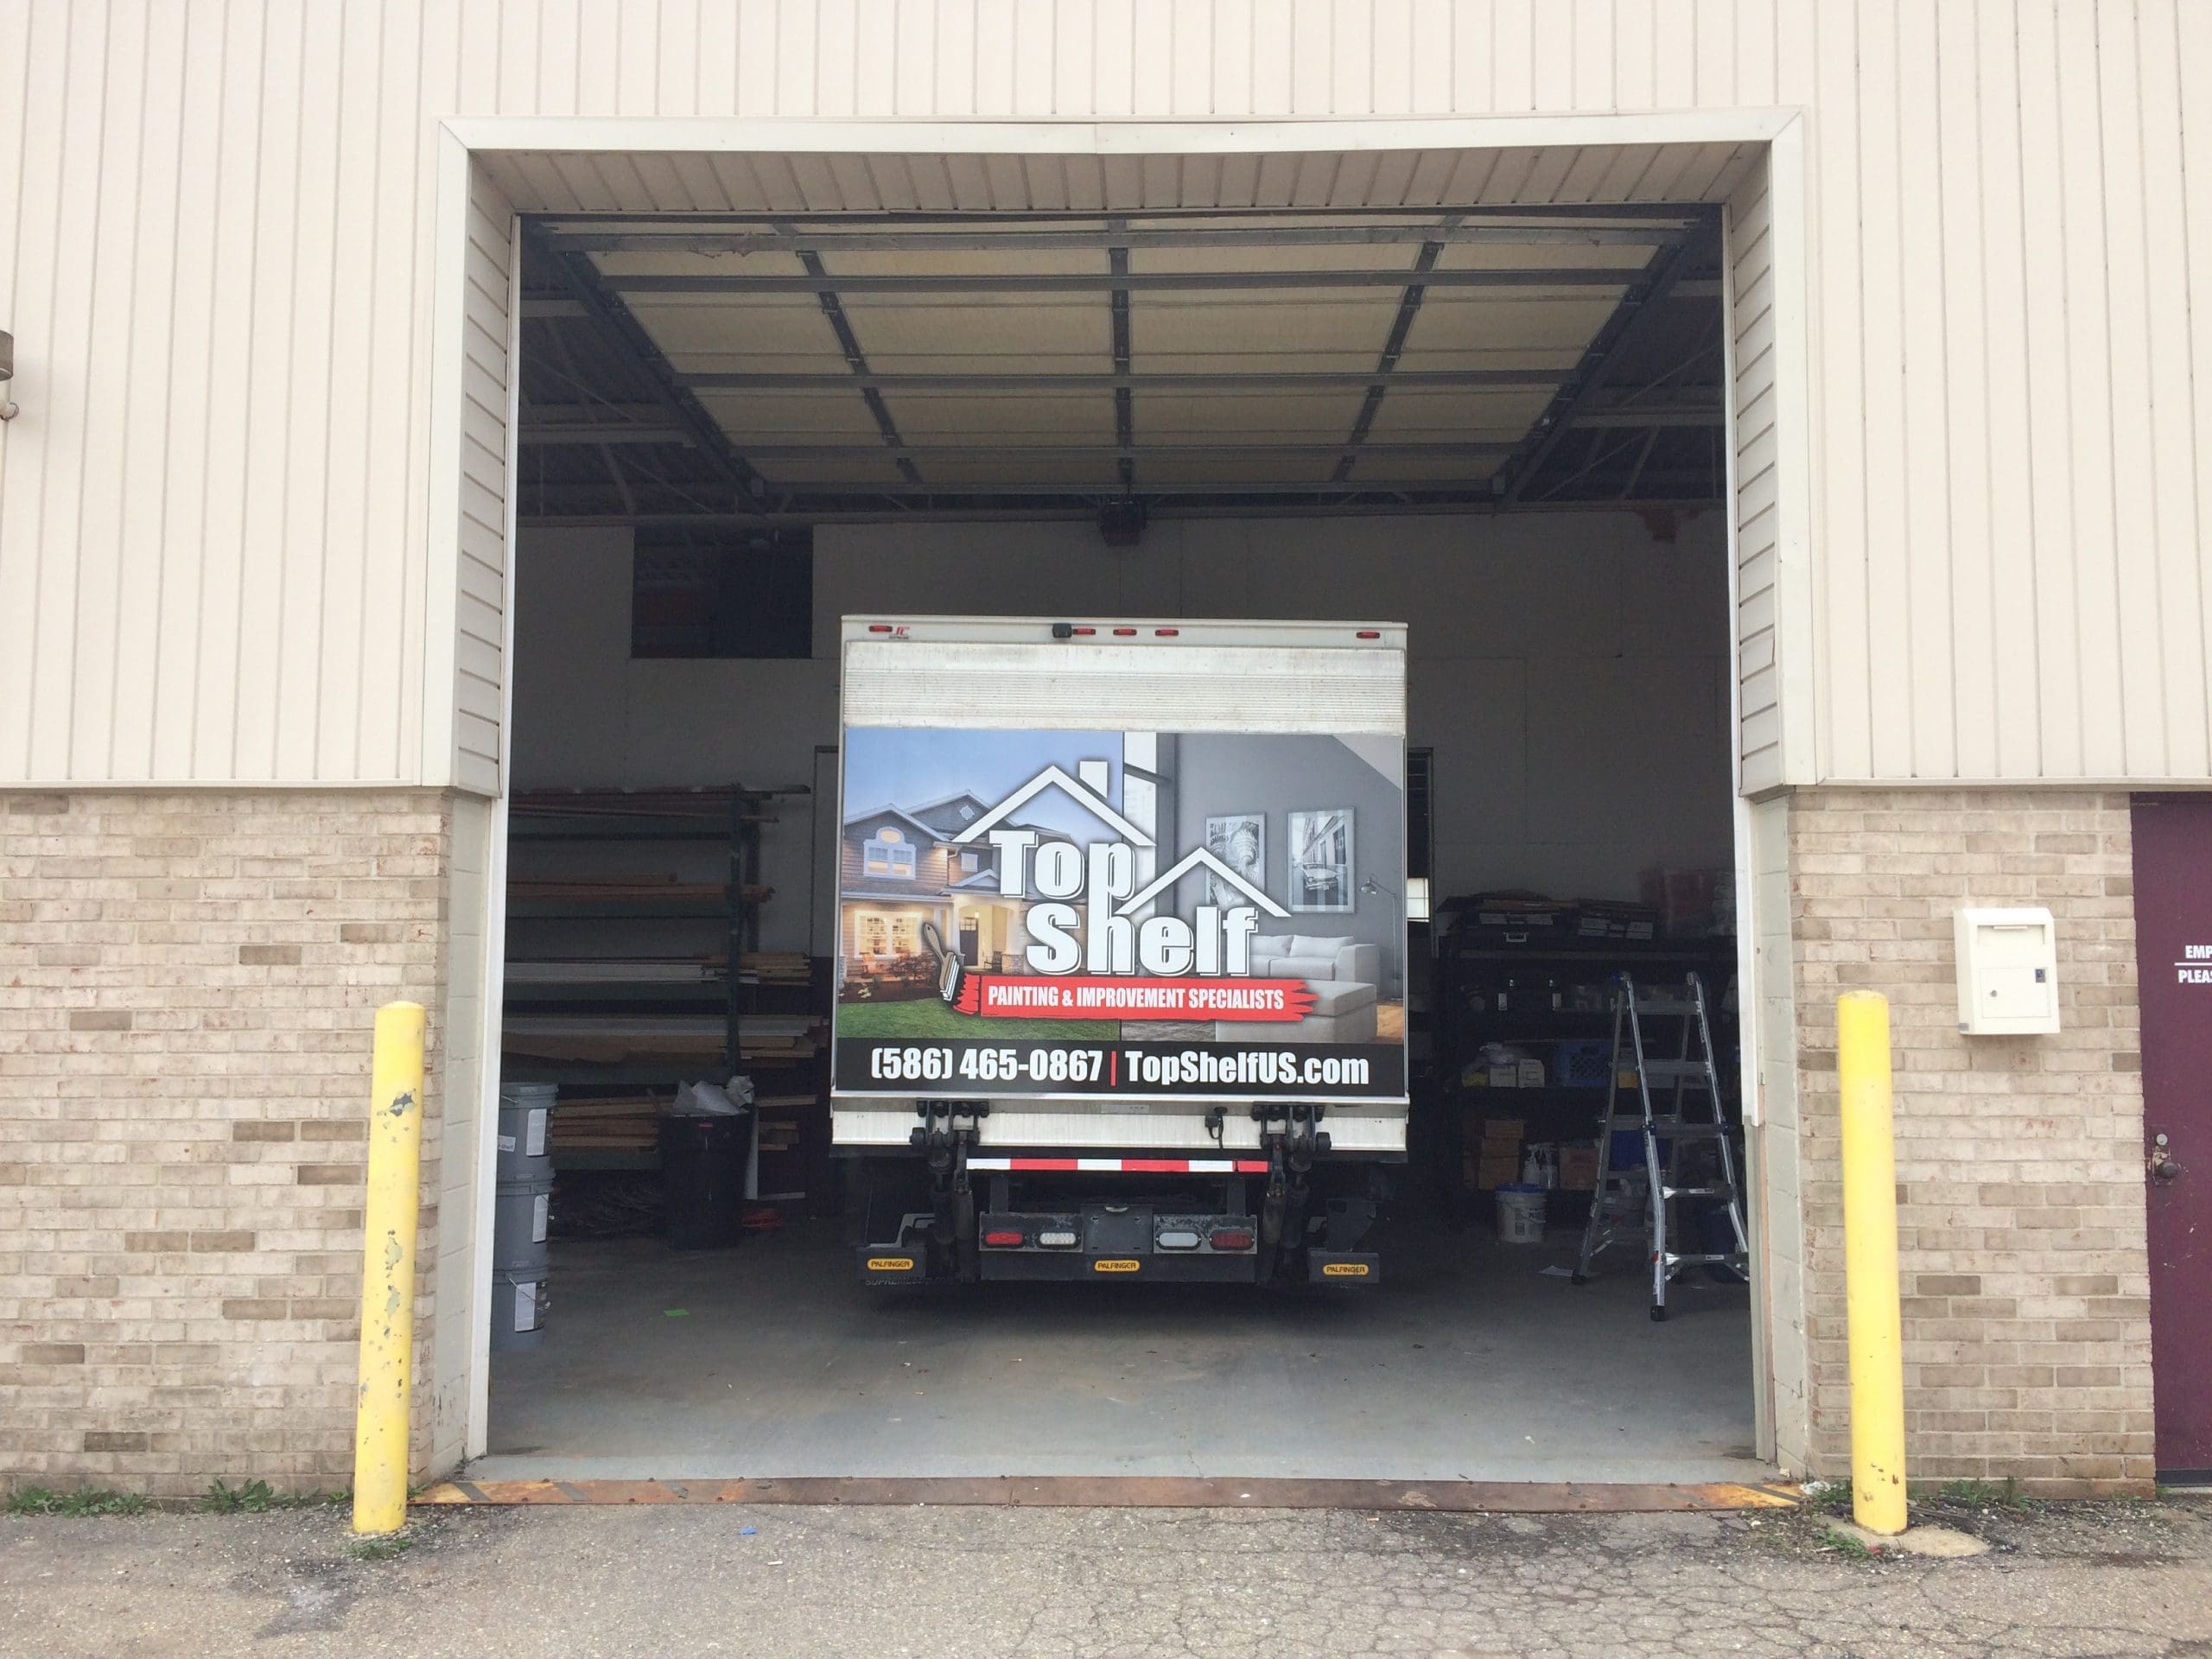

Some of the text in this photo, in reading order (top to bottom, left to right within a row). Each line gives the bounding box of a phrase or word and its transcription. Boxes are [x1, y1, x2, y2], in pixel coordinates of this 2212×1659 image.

[989, 830, 1136, 900] Top
[1026, 901, 1259, 976] Shelf
[988, 985, 1284, 1010] PAINTING & IMPROVEMENT SPECIALISTS
[871, 1047, 1370, 1085] (586) 465-0867 TopShelfUS.com
